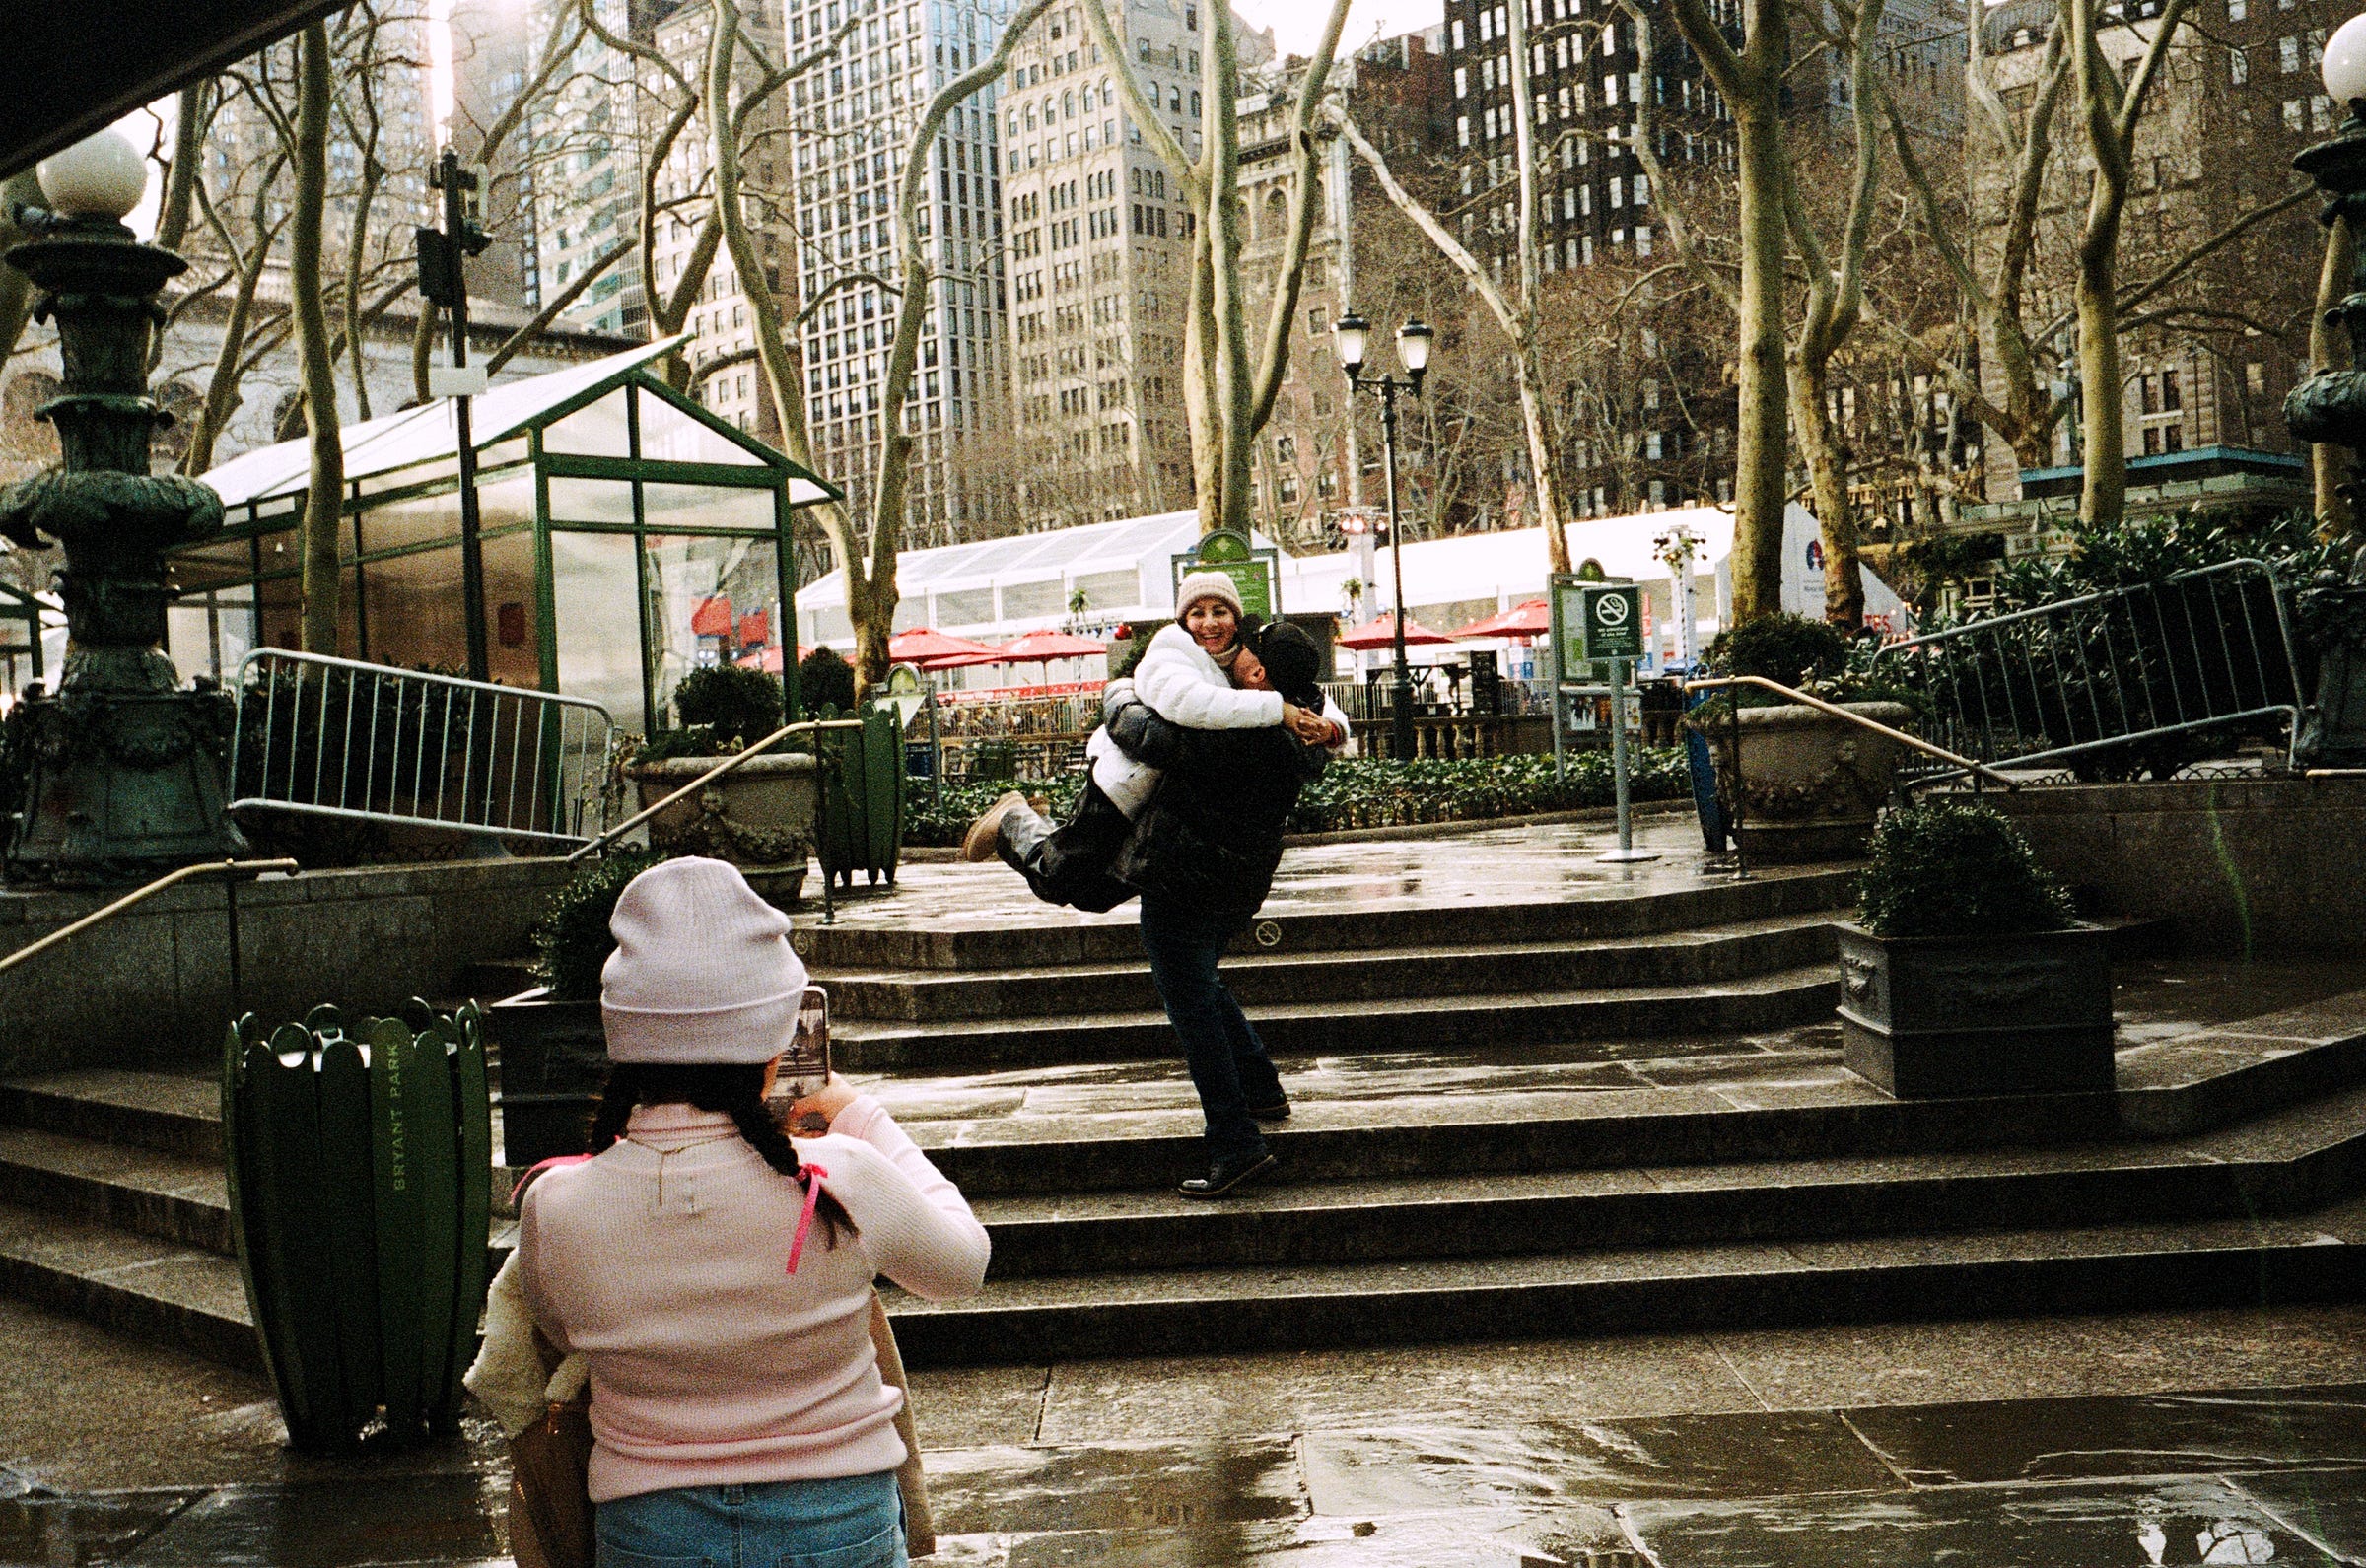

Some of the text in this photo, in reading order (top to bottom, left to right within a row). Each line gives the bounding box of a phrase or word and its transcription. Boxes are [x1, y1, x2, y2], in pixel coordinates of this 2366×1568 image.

[1862, 614, 1892, 634] TES
[386, 1043, 406, 1191] BRYANT PARK
